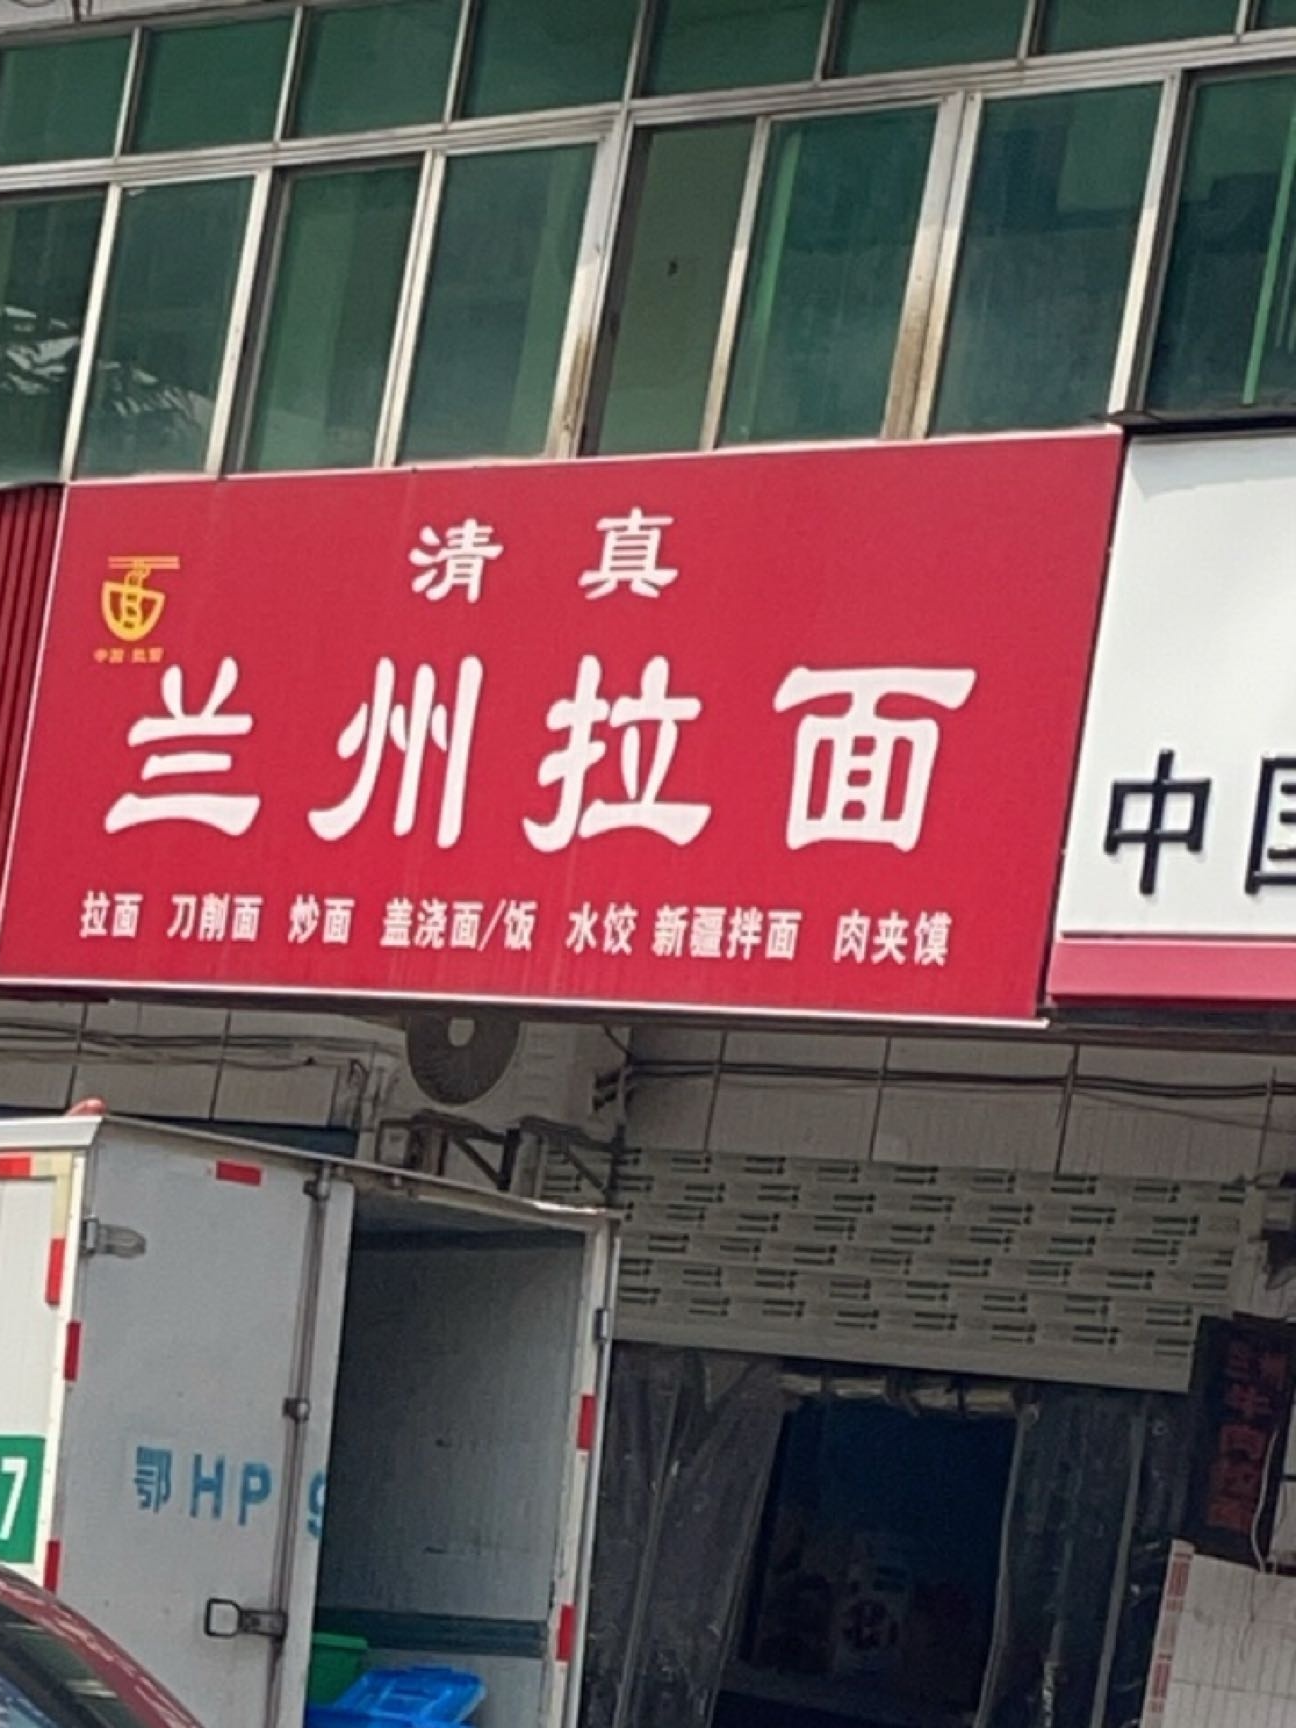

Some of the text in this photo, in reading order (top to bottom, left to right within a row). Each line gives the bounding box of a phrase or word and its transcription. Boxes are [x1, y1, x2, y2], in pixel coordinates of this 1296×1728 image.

[408, 507, 680, 603] 清真
[104, 654, 977, 853] 兰州拉面
[79, 890, 953, 966] 拉面 刀削面 炒面 盖浇面/饭 水饺 新疆拌面 肉夹馍
